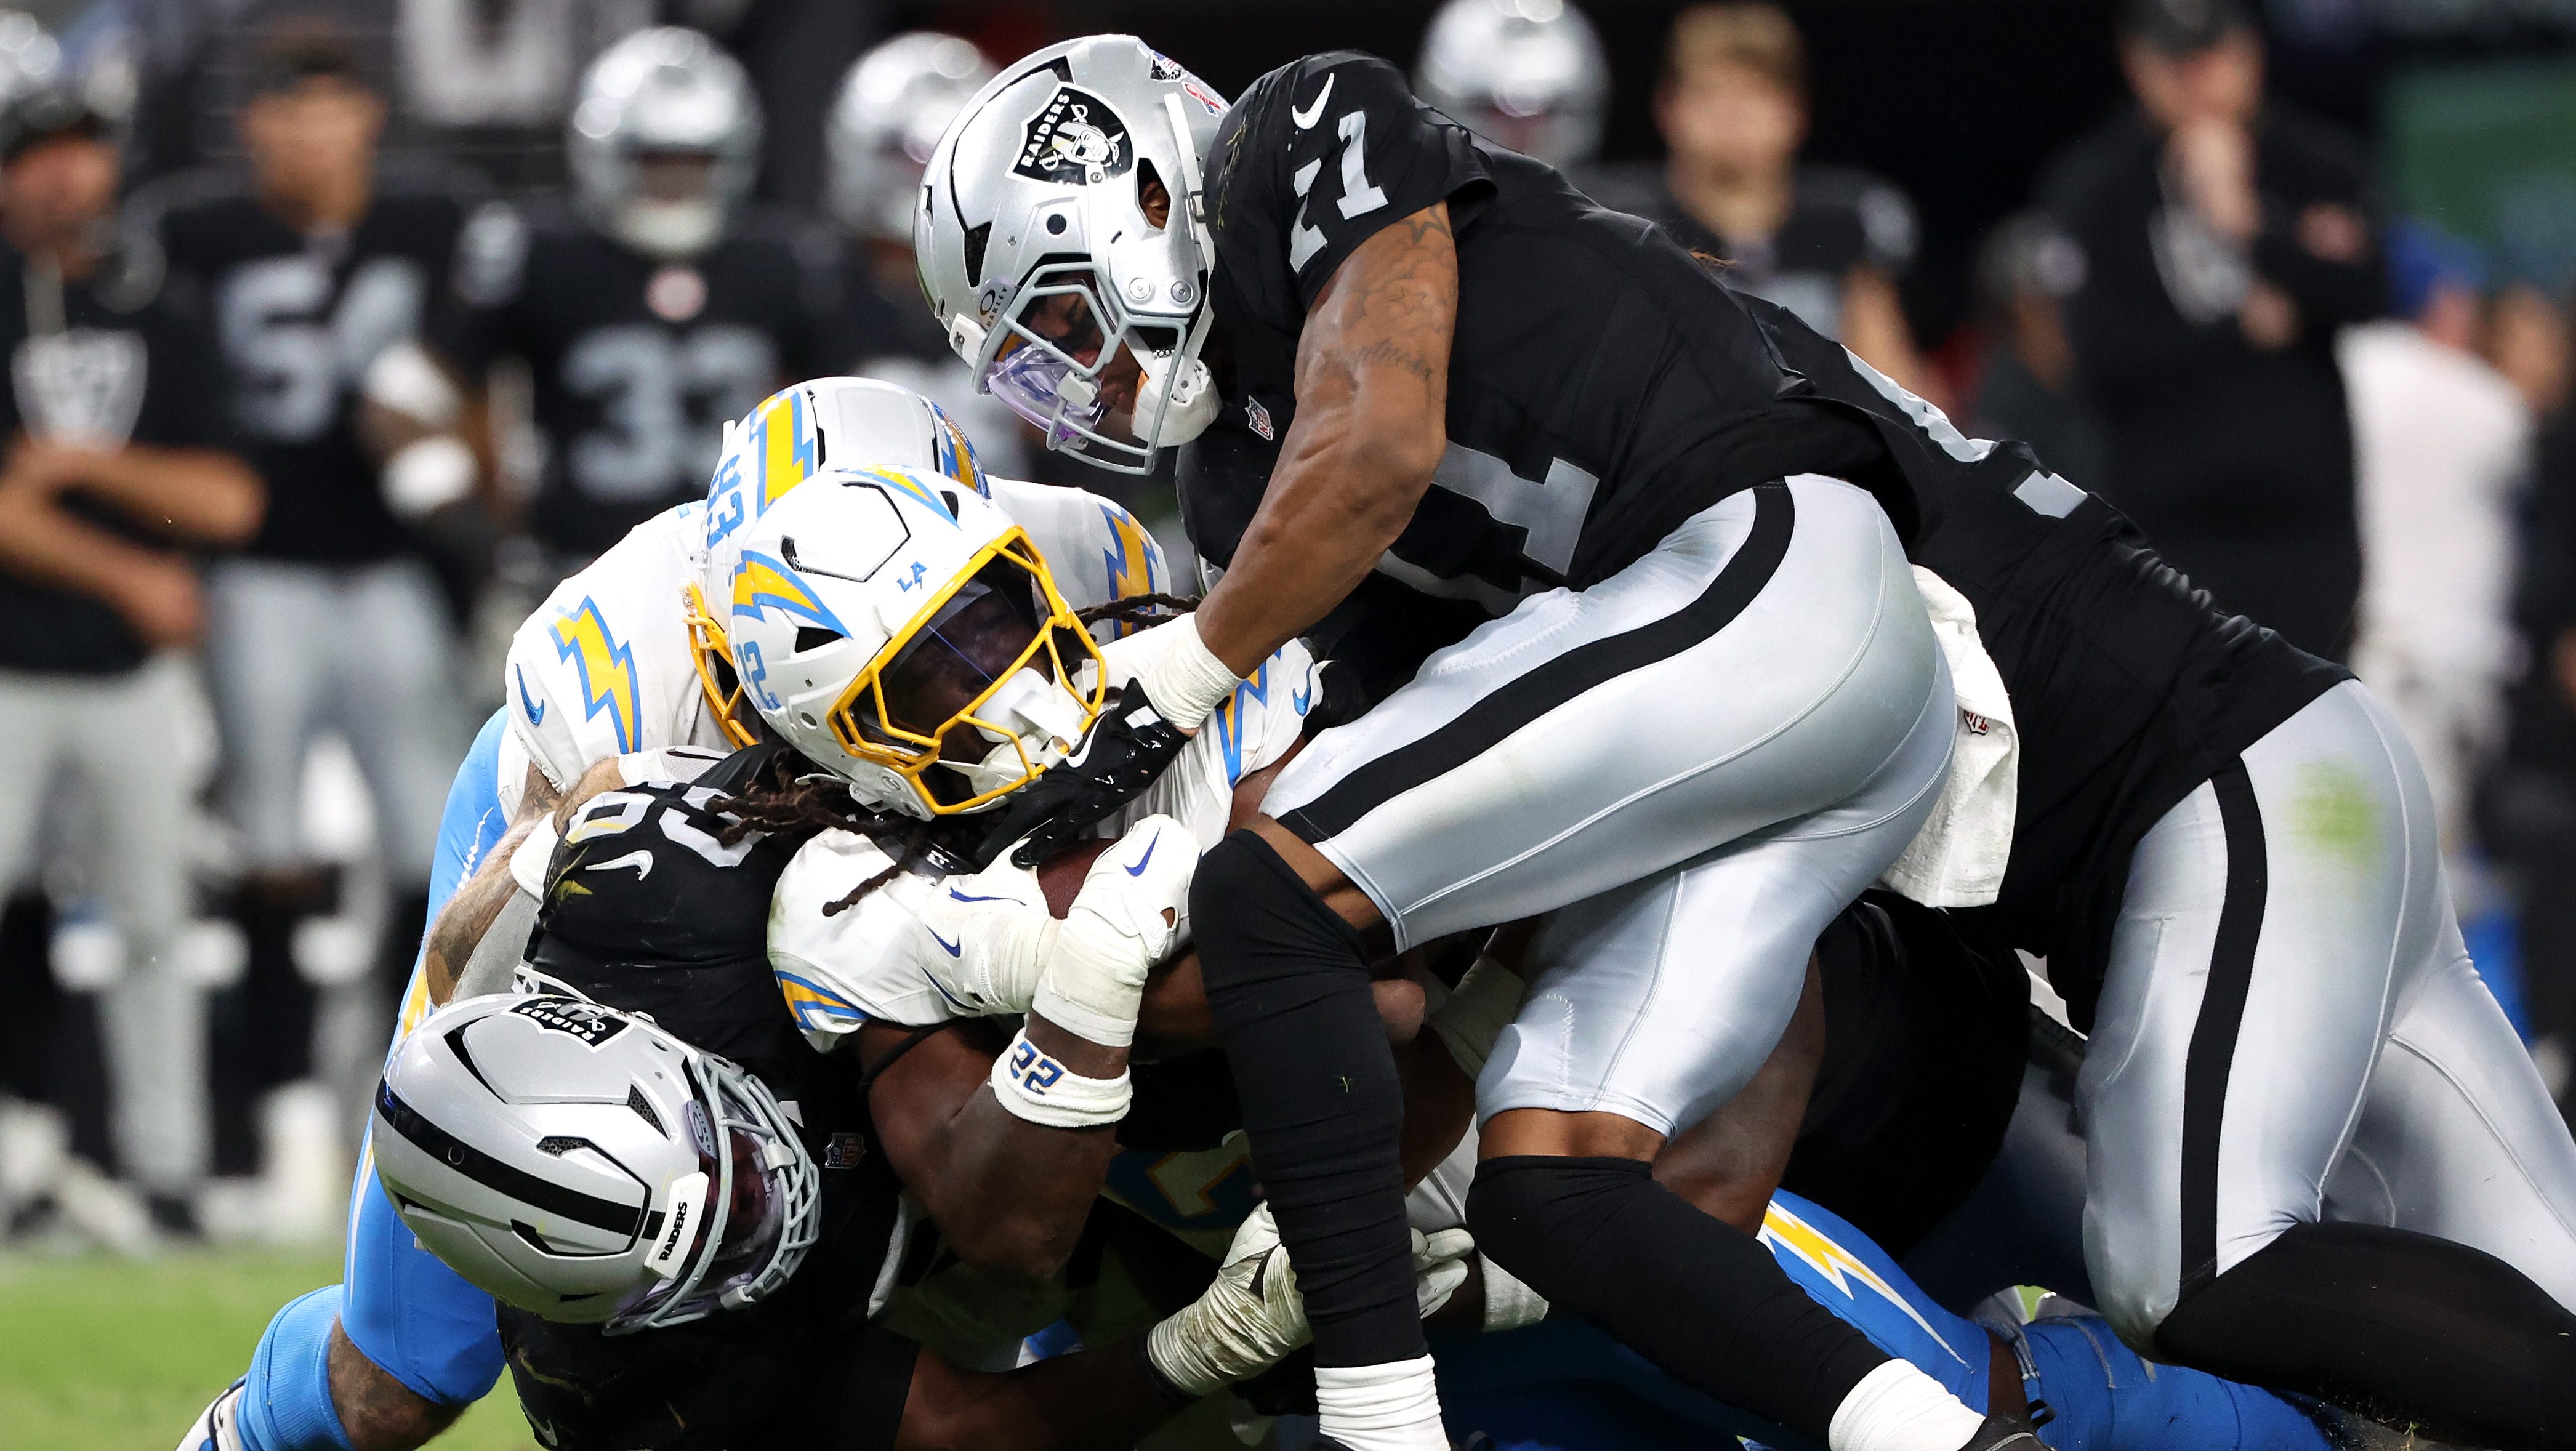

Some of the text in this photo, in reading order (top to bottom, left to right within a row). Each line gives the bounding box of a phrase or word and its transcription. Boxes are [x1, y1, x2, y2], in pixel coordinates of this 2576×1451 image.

[1020, 94, 1069, 167] RAIDERS
[1289, 110, 1389, 275] 11
[986, 286, 1007, 327] OAKLEY
[896, 561, 927, 592] LA
[520, 1007, 595, 1040] RAIDERS
[1010, 1041, 1064, 1095] 22
[659, 1202, 688, 1261] RAIDERS
